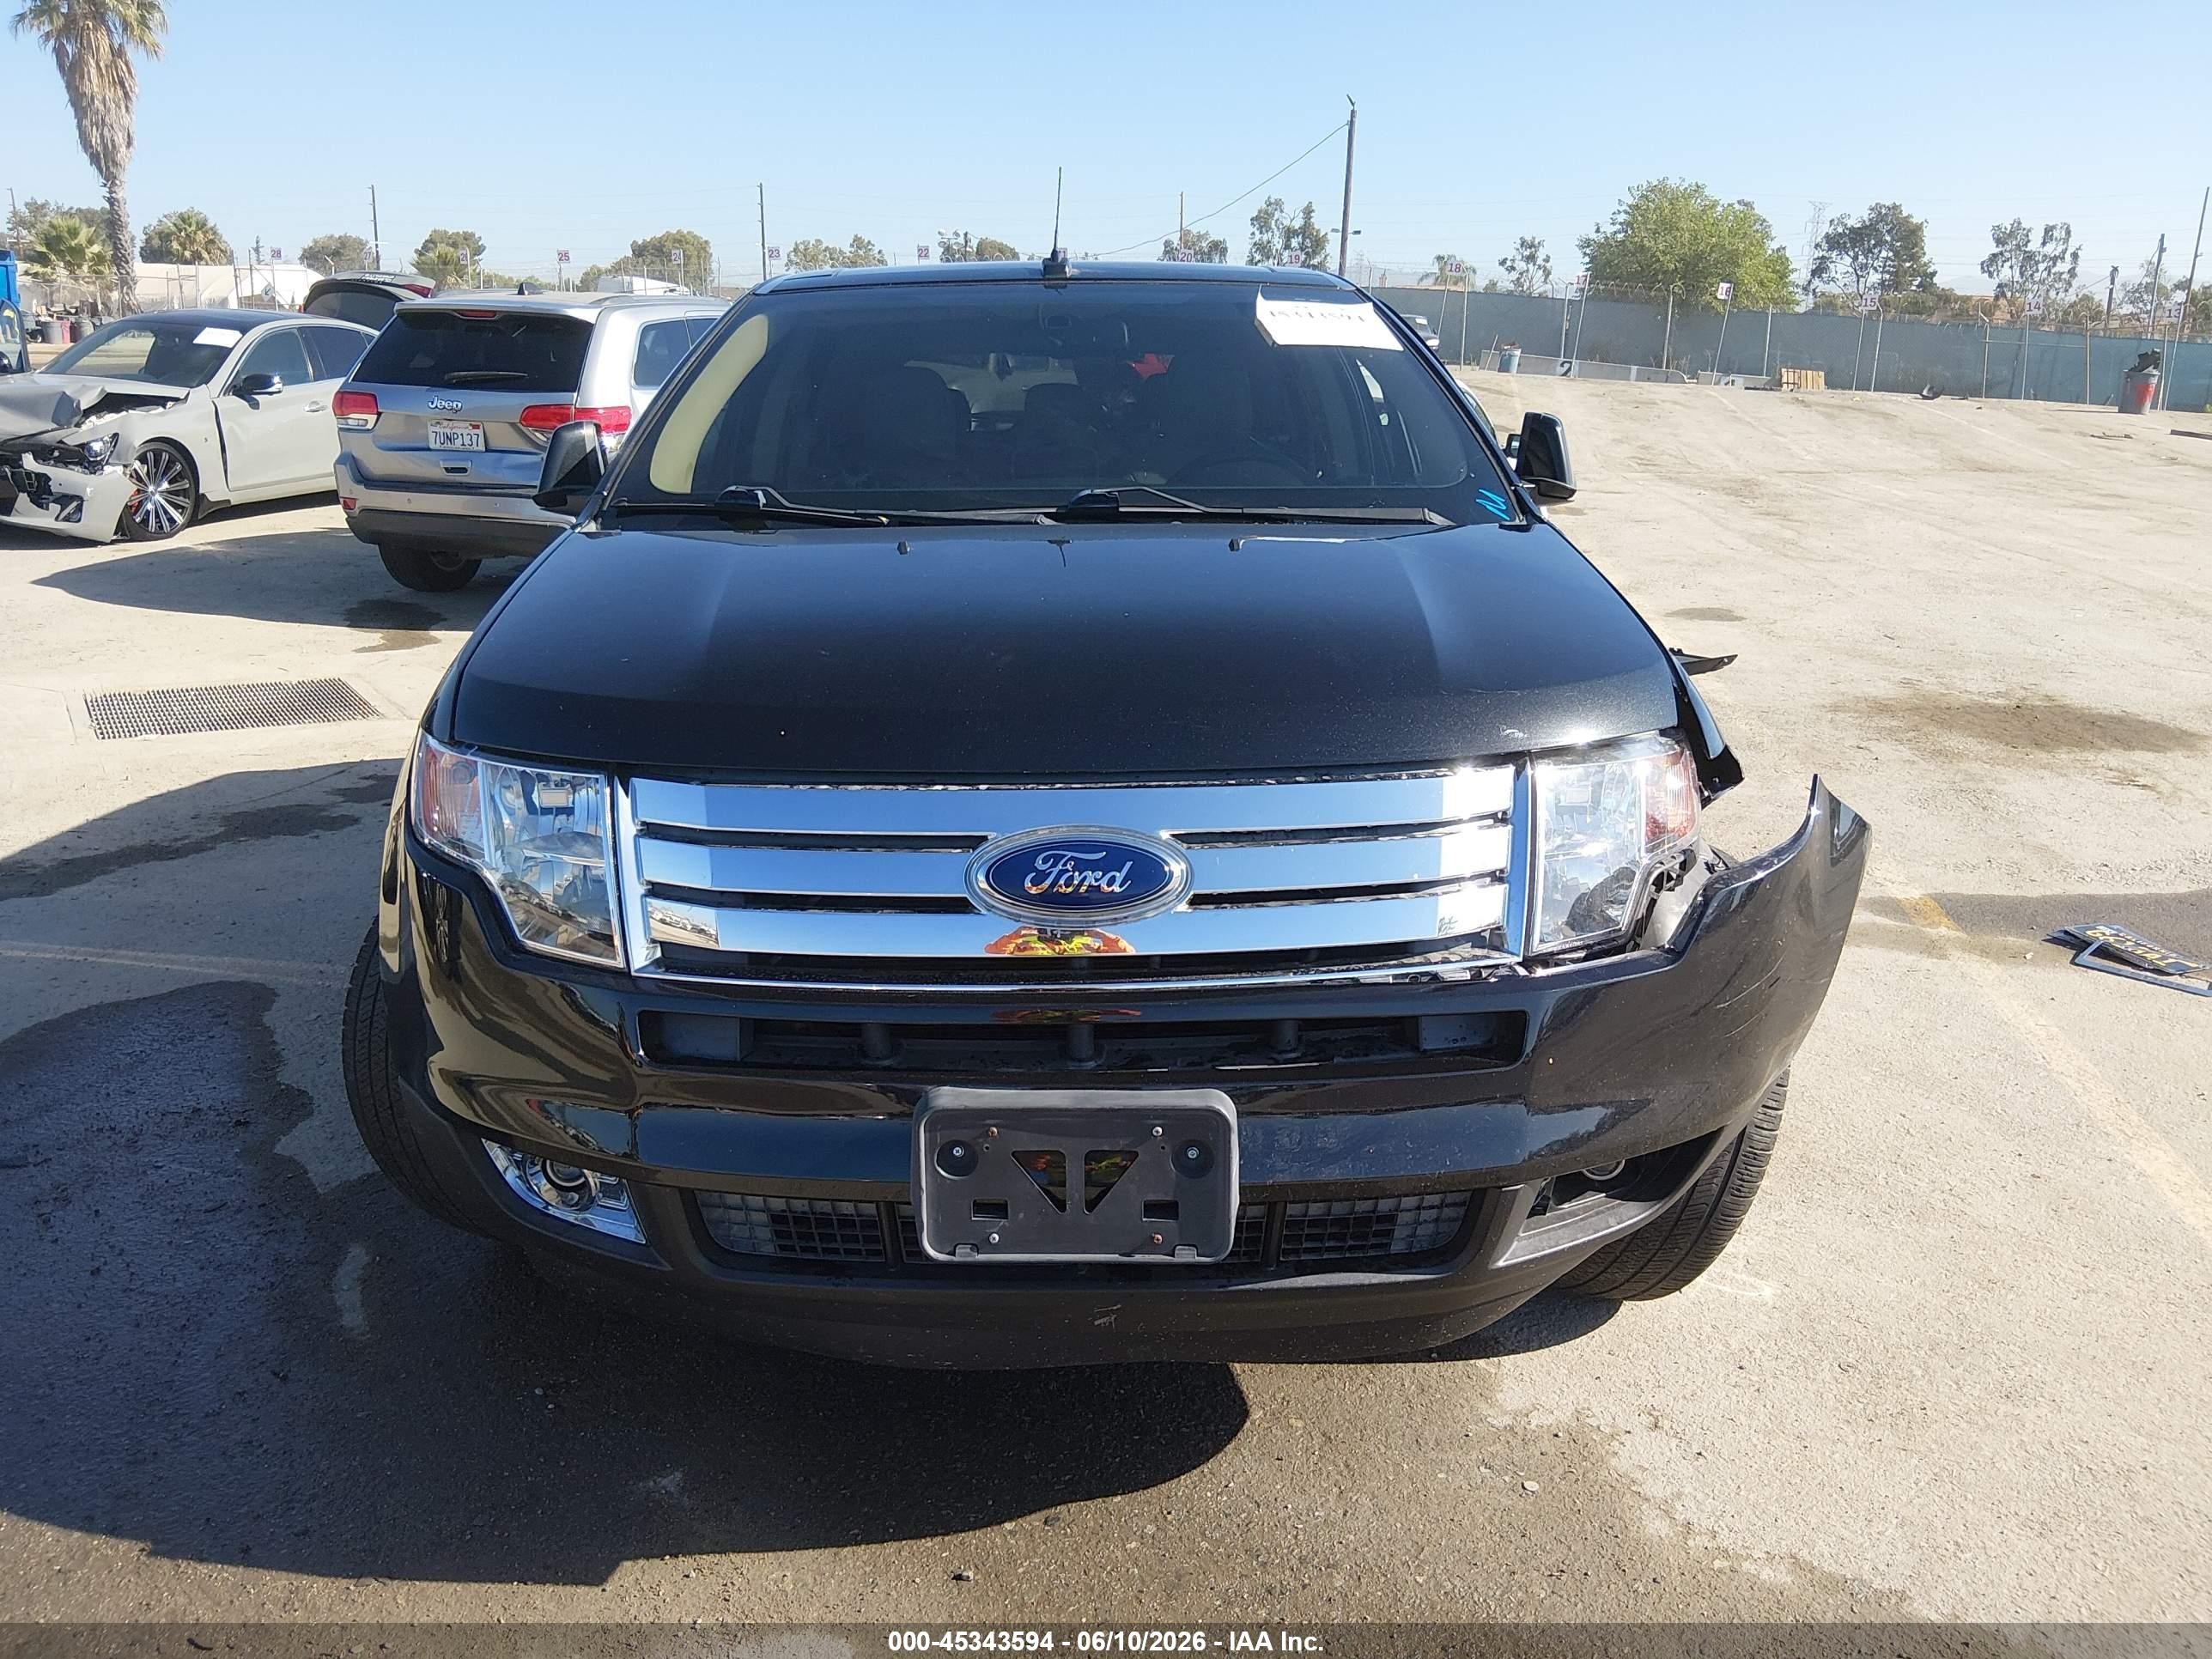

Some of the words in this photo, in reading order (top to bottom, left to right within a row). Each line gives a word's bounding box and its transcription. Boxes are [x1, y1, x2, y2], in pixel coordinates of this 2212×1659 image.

[270, 249, 282, 258] 28
[557, 252, 570, 262] 25
[768, 248, 781, 258] 23
[917, 247, 930, 258] 22
[1179, 252, 1193, 262] 20
[1289, 253, 1301, 264] 19
[1449, 263, 1462, 273] 18
[1862, 297, 1876, 307] 15
[2027, 301, 2041, 313] 14
[2166, 309, 2181, 319] 13
[1559, 361, 1572, 377] 2
[428, 395, 462, 413] Jeep
[431, 430, 480, 447] 7UNP137
[1024, 850, 1133, 894] Ford
